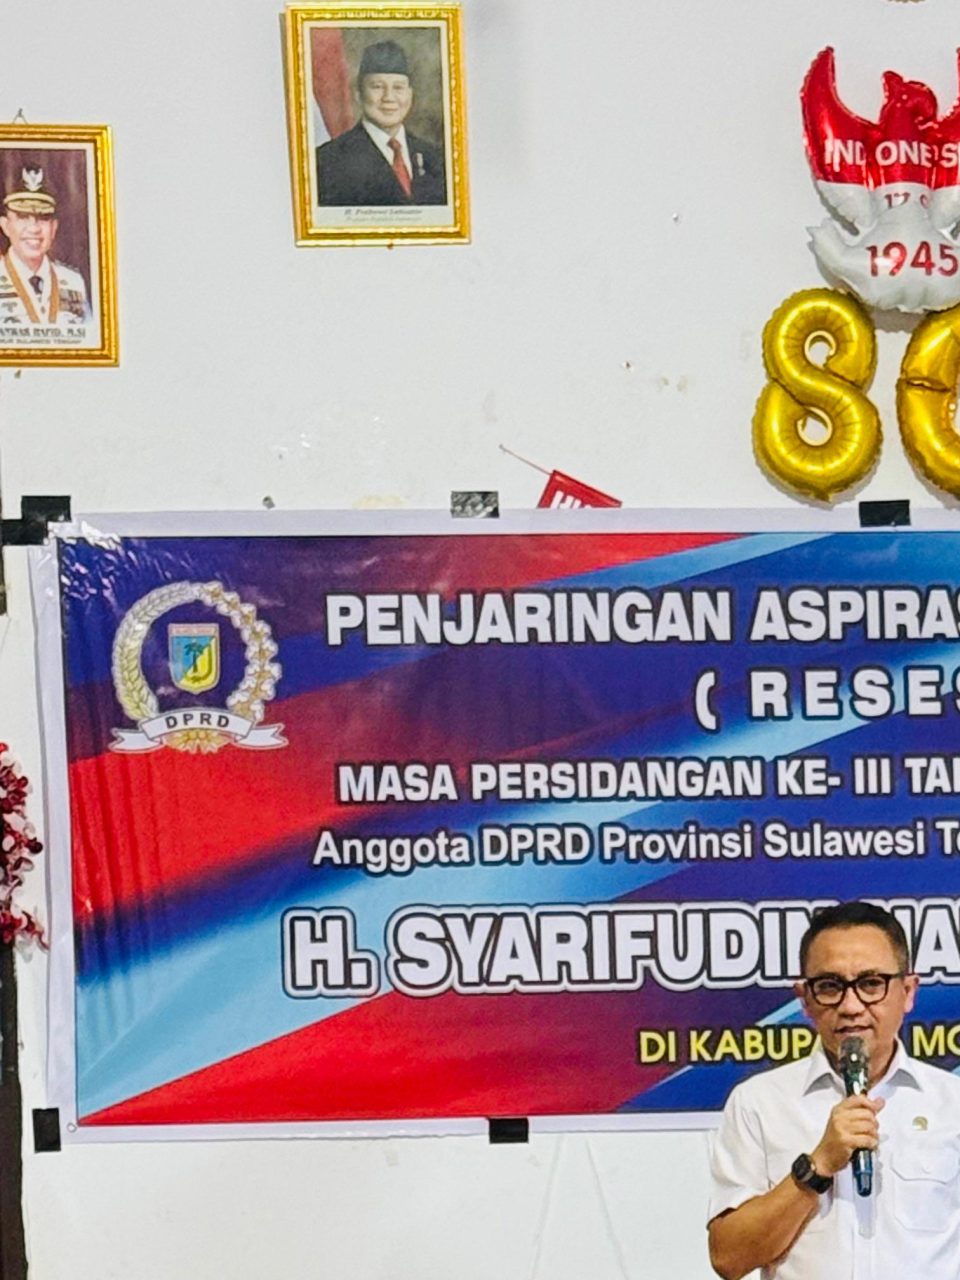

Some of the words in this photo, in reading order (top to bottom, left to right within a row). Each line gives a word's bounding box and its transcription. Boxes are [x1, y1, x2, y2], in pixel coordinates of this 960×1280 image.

[866, 241, 959, 277] 1945
[325, 590, 731, 646] PENJARINGAN
[165, 713, 230, 729] DPRD
[338, 764, 459, 802] MASA
[471, 760, 763, 800] PERSIDANGAN
[777, 759, 841, 797] KE-
[854, 758, 892, 794] III
[313, 829, 470, 873] Anggota
[481, 826, 591, 863] DPRD
[602, 824, 752, 861] Provinsi
[763, 820, 925, 860] Sulawesi
[286, 909, 377, 993] H.
[639, 1030, 677, 1064] DI
[689, 1027, 824, 1063] KABUP
